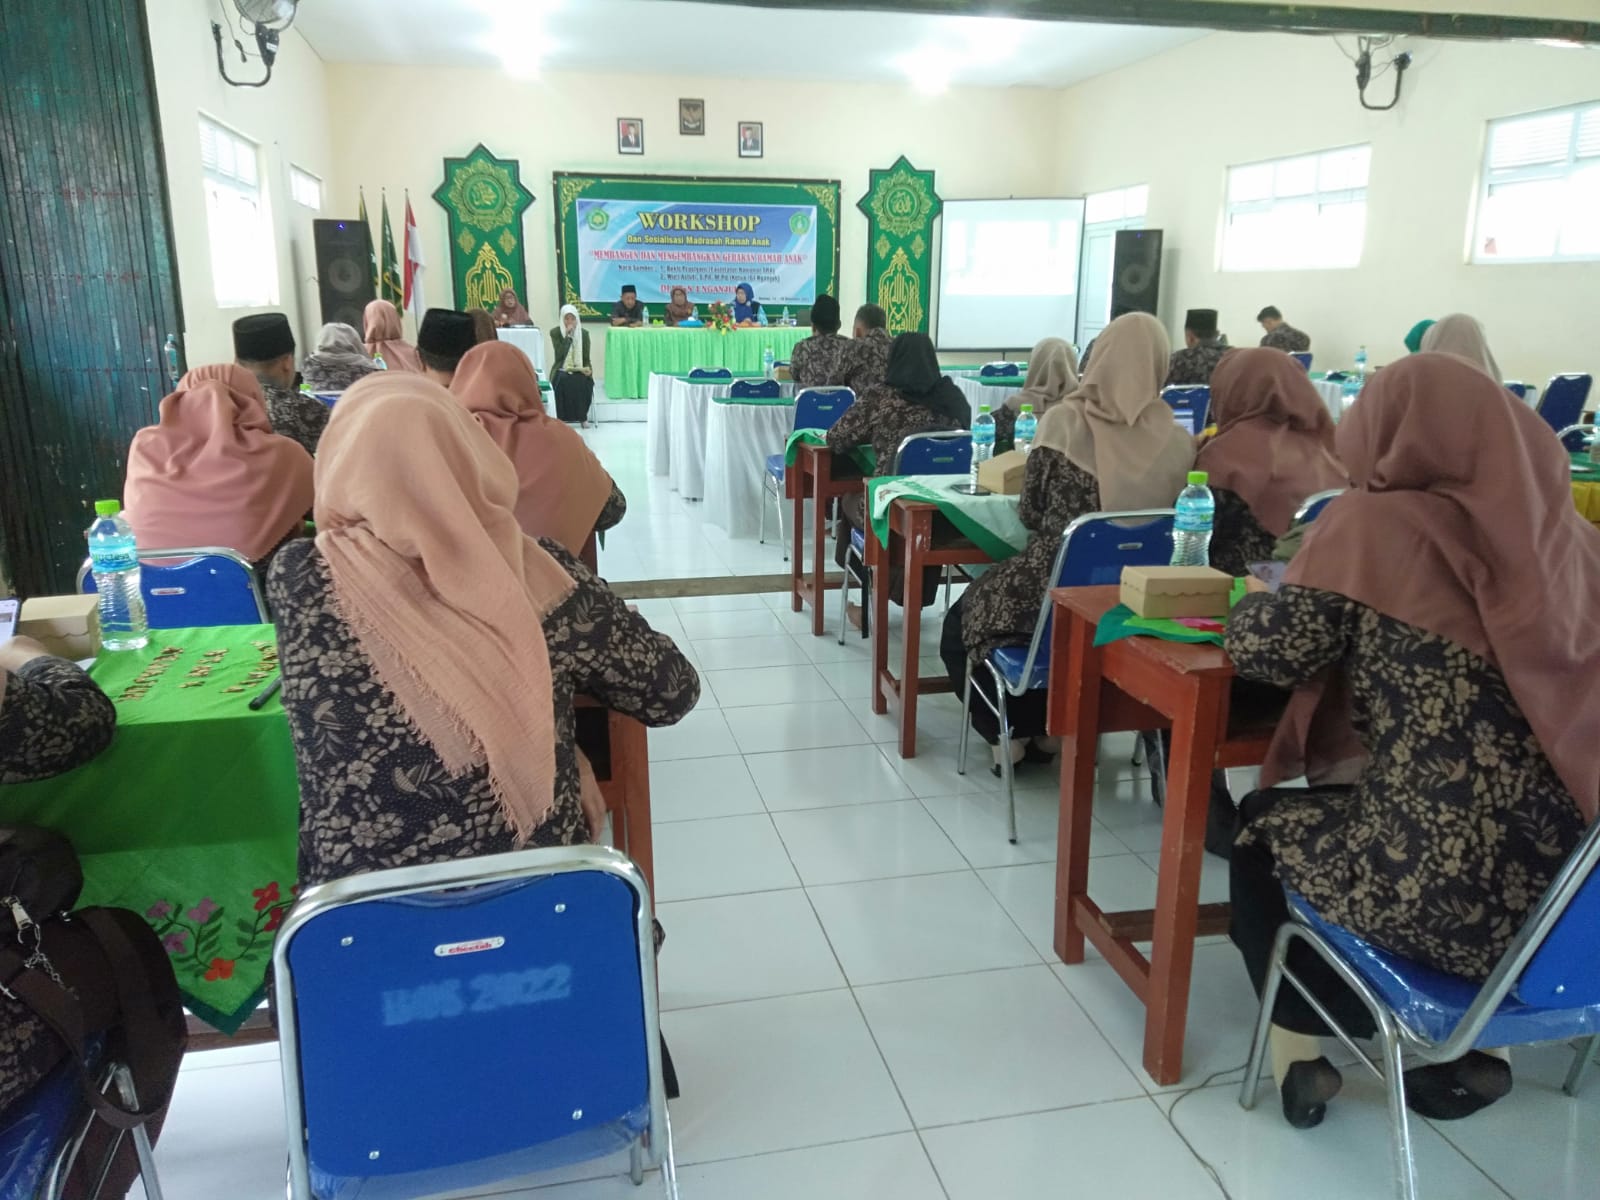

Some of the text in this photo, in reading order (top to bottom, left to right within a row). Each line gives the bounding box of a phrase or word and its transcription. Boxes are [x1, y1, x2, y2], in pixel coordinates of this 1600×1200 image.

[637, 211, 761, 232] WORKSHOP
[627, 234, 771, 247] Dan Sosialisasi Madrasah Ramah Anak
[640, 251, 657, 261] DAN
[658, 251, 721, 263] MENGEMBANGKAN
[723, 252, 756, 263] GERAKAN
[757, 253, 782, 264] RAMAH
[702, 286, 737, 294] NGANJU
[470, 963, 572, 1013] 2022
